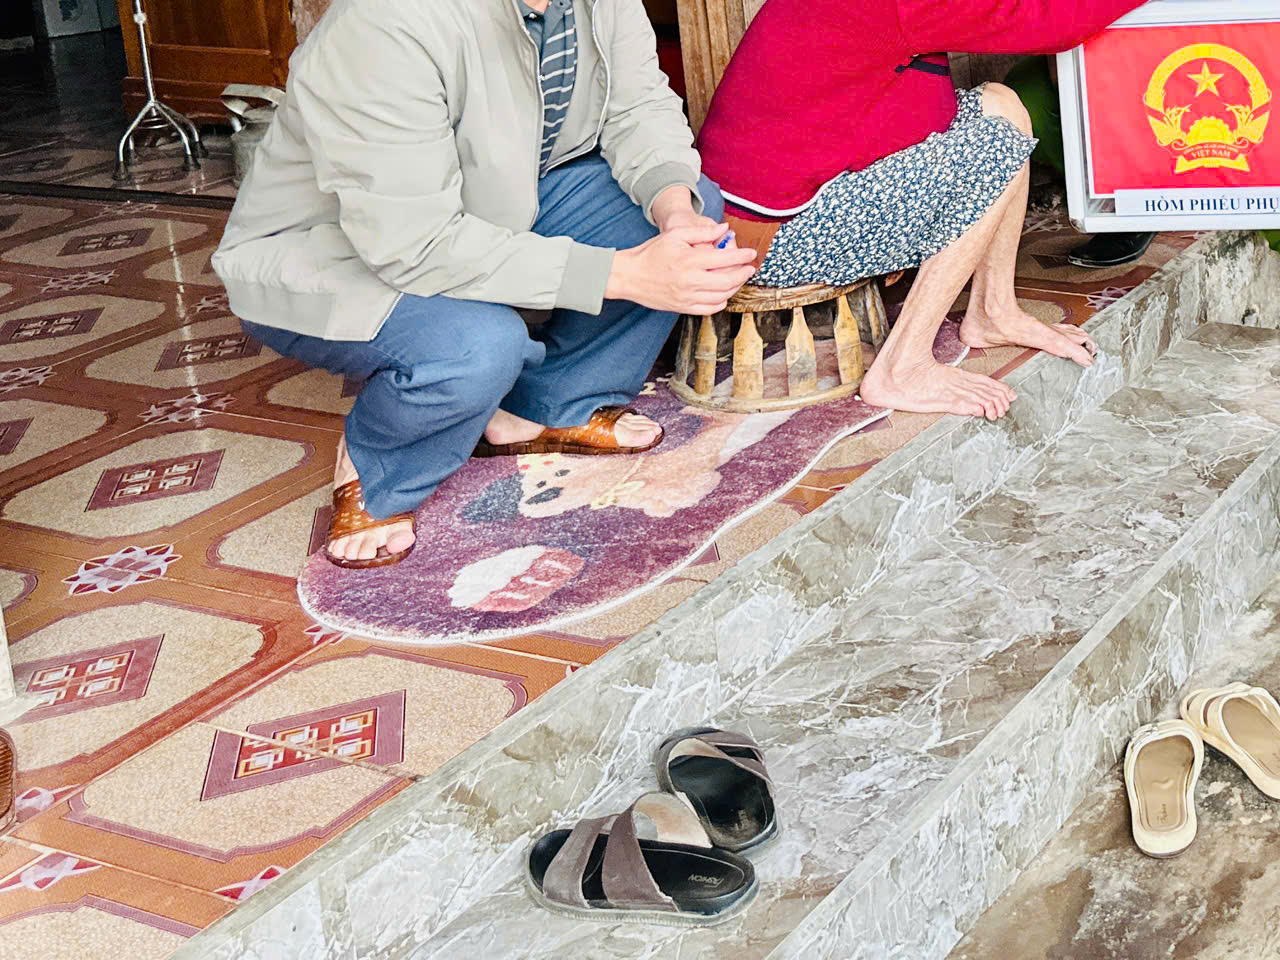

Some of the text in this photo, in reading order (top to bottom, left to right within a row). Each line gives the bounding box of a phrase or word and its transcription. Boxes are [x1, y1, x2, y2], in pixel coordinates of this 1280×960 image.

[1145, 194, 1279, 213] HÒM PHIẾU PHỤ
